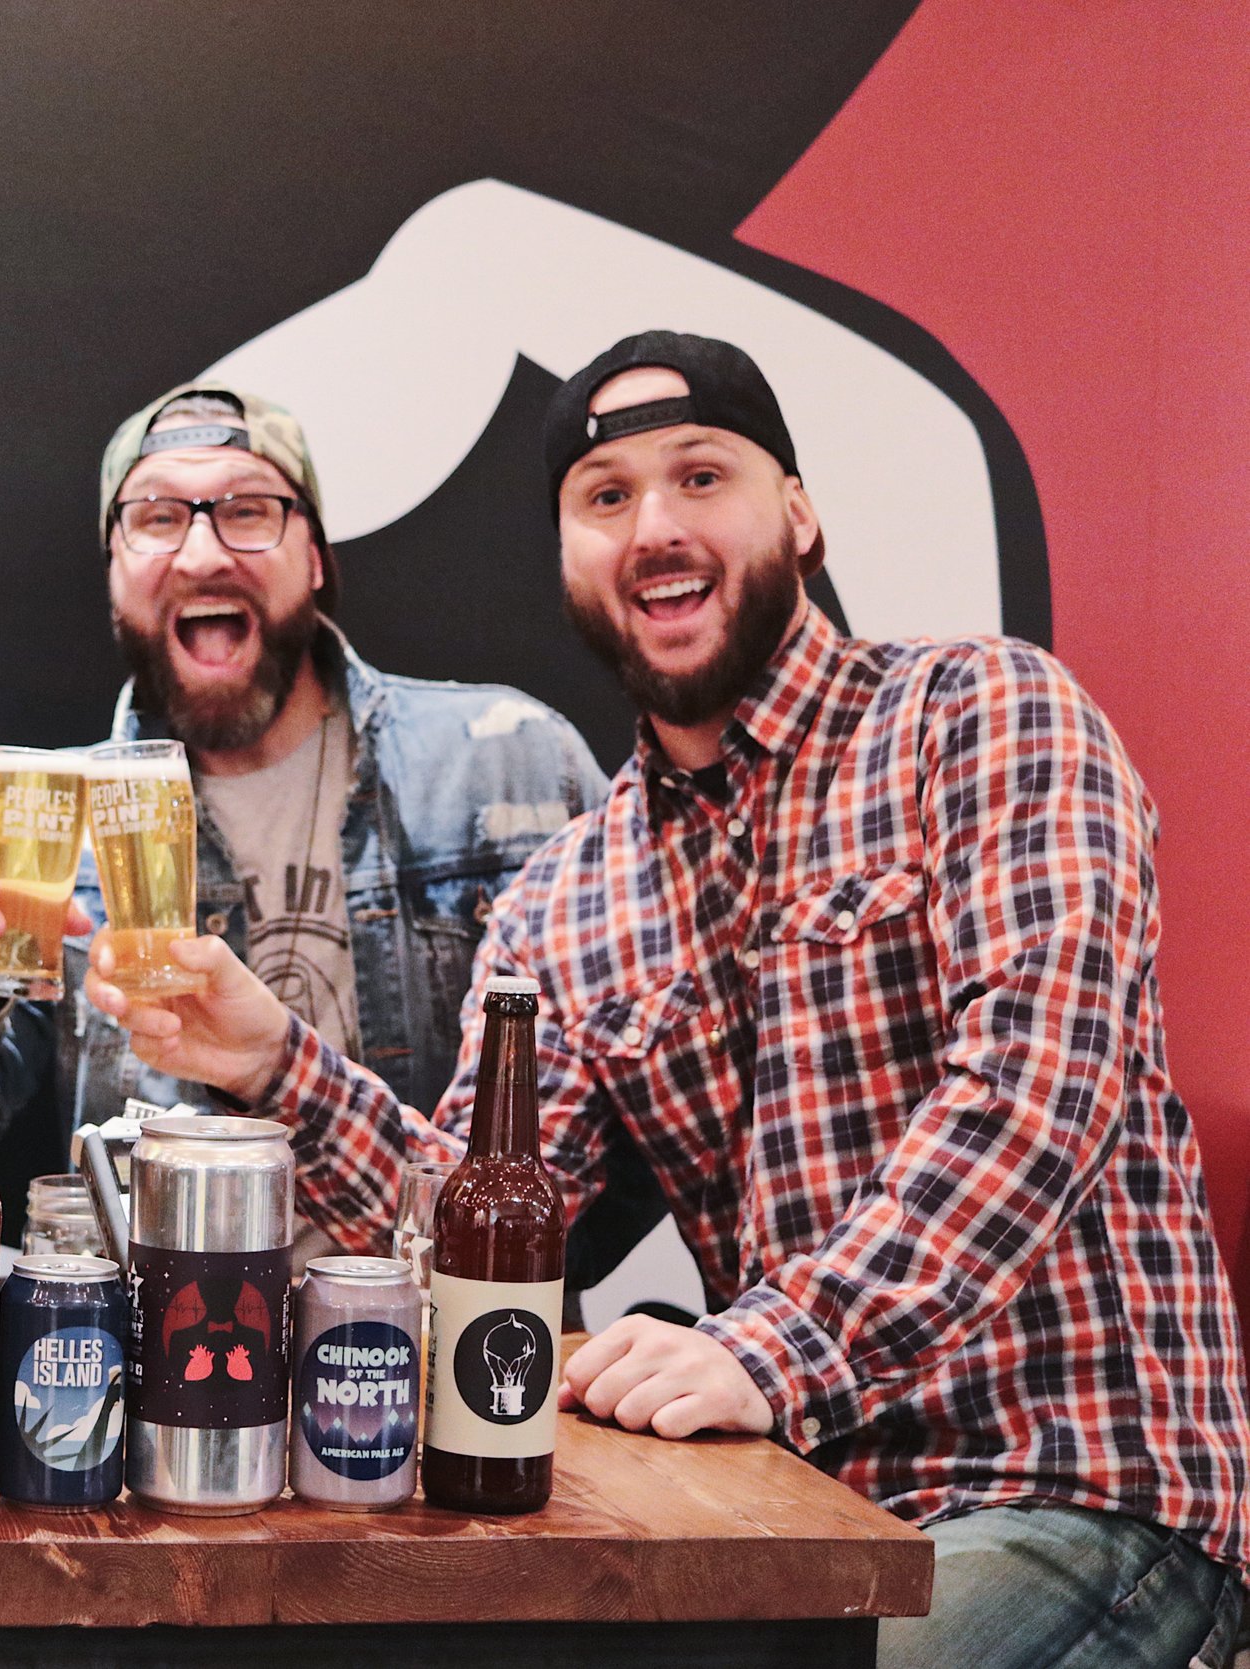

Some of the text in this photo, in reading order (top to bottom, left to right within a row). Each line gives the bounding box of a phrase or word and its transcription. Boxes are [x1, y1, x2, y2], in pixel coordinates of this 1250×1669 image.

[5, 785, 76, 815] PEOPLE'S
[91, 779, 159, 808] PEOPLE'S
[3, 809, 75, 831] PINT
[93, 802, 159, 826] PINT
[34, 1337, 103, 1364] HELLES
[316, 1344, 410, 1367] CHINOOK
[33, 1360, 103, 1387] ISLAND
[347, 1368, 386, 1380] OF THE
[317, 1377, 410, 1407] NORTH
[321, 1446, 405, 1459] AMERICAN PALE ALE
